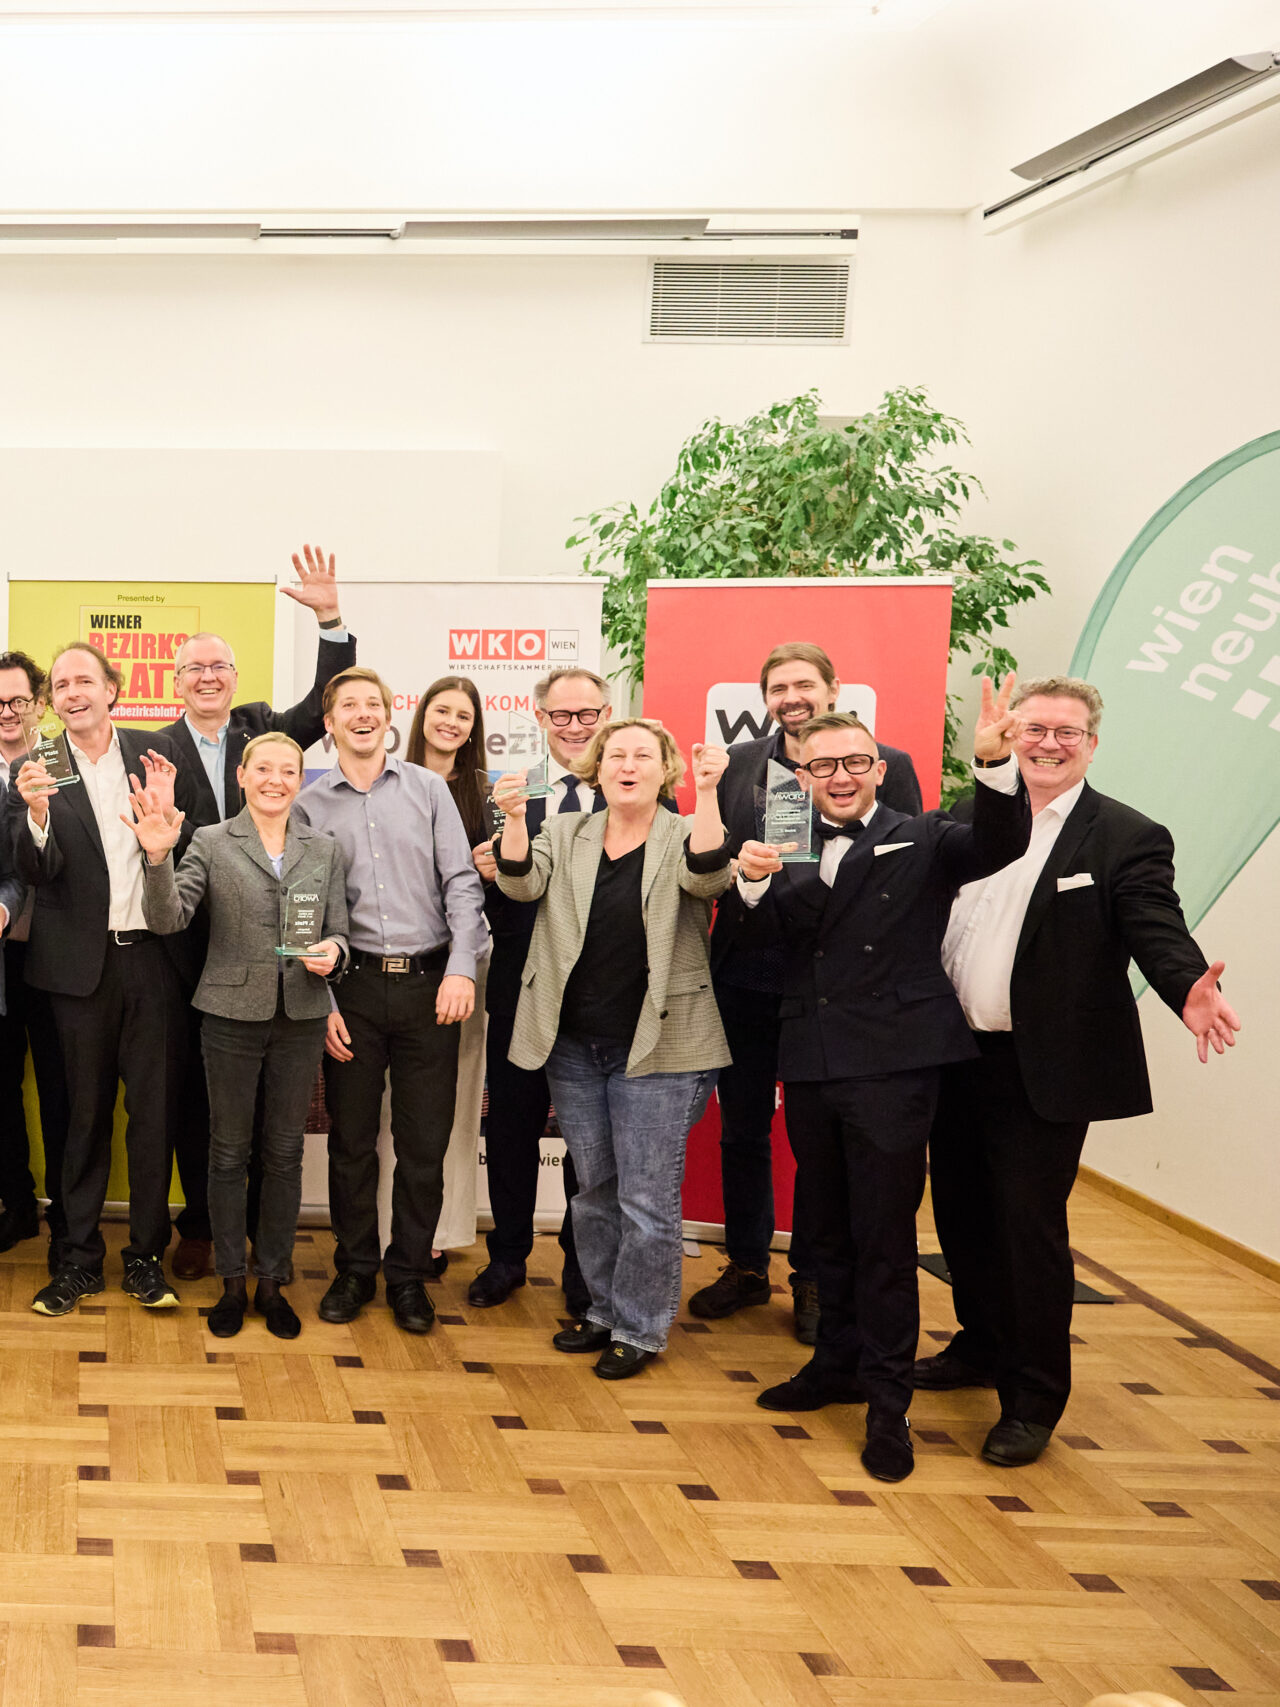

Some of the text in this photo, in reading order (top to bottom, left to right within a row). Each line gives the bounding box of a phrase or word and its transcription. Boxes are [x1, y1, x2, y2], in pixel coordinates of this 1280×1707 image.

[117, 594, 165, 603] Presented by
[1124, 544, 1255, 674] wien
[90, 614, 142, 629] WIENER
[450, 632, 576, 657] WKO WIEN
[448, 663, 553, 671] WIRTSCHAFTSKAMMER
[486, 725, 546, 756] ezi
